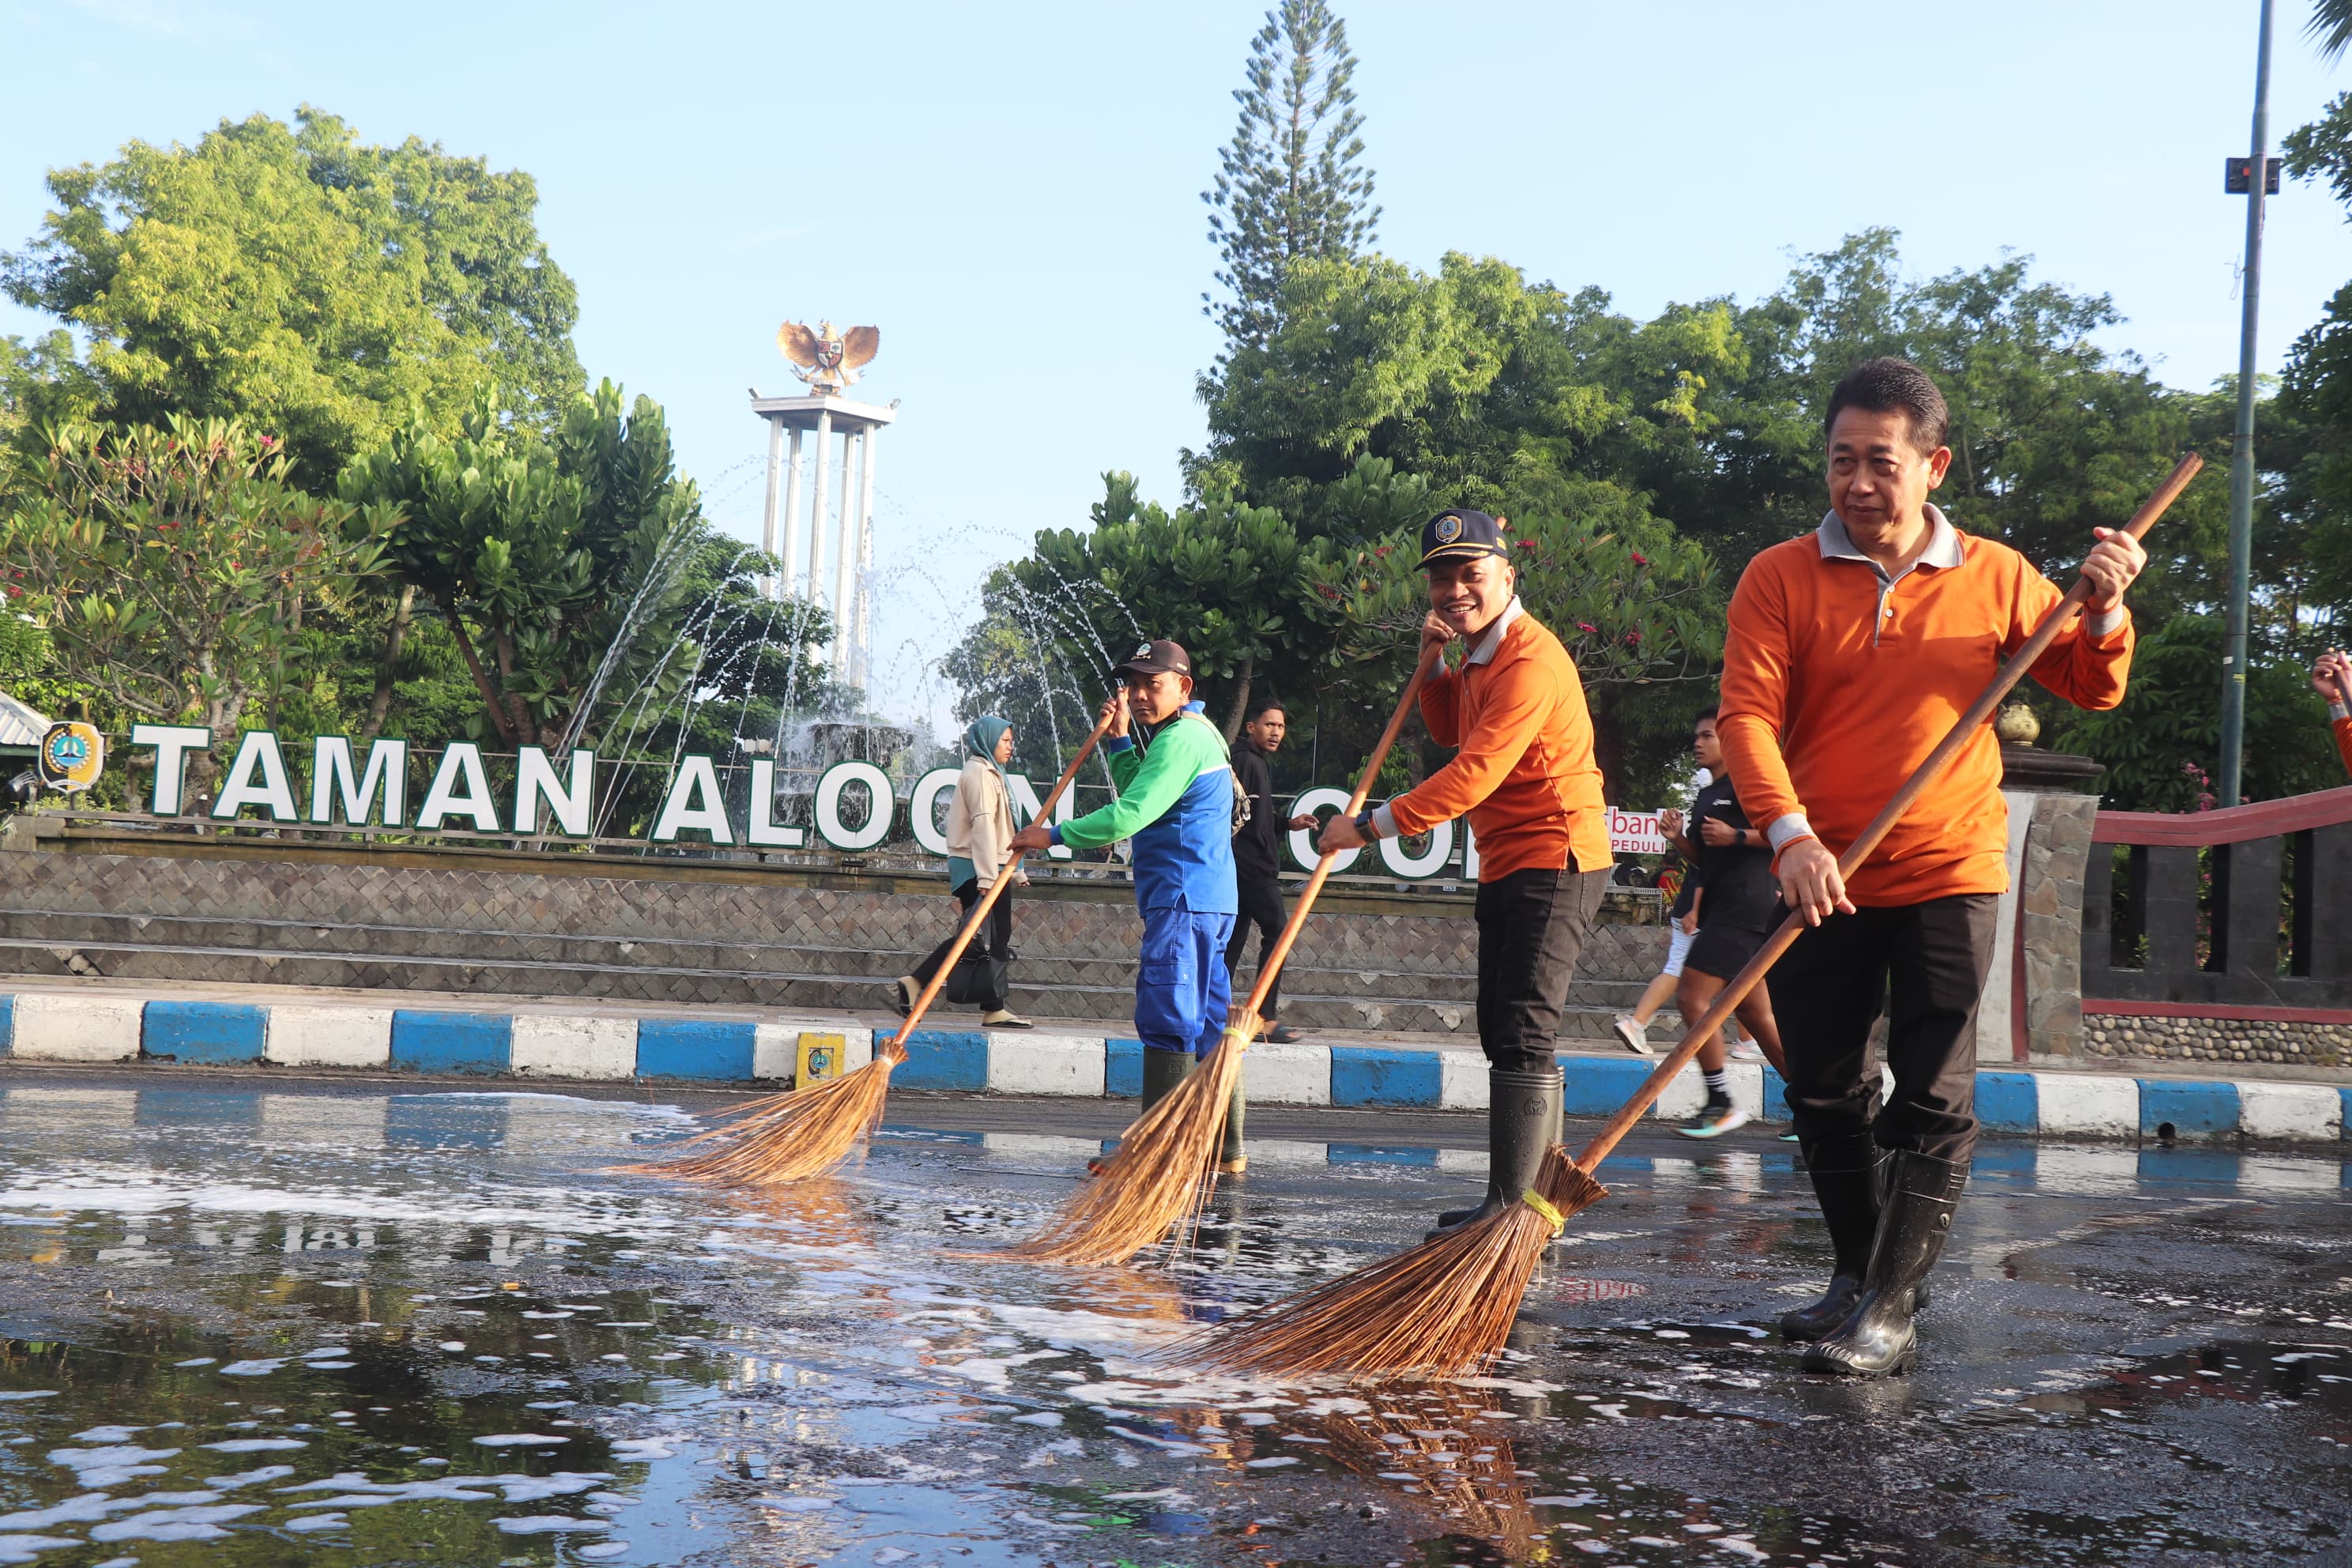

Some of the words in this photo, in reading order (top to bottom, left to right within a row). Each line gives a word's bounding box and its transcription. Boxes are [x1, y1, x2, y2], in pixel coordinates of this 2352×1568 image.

[130, 722, 597, 837] TAMAN
[1611, 808, 1668, 835] ban
[1611, 839, 1665, 854] PEDULI
